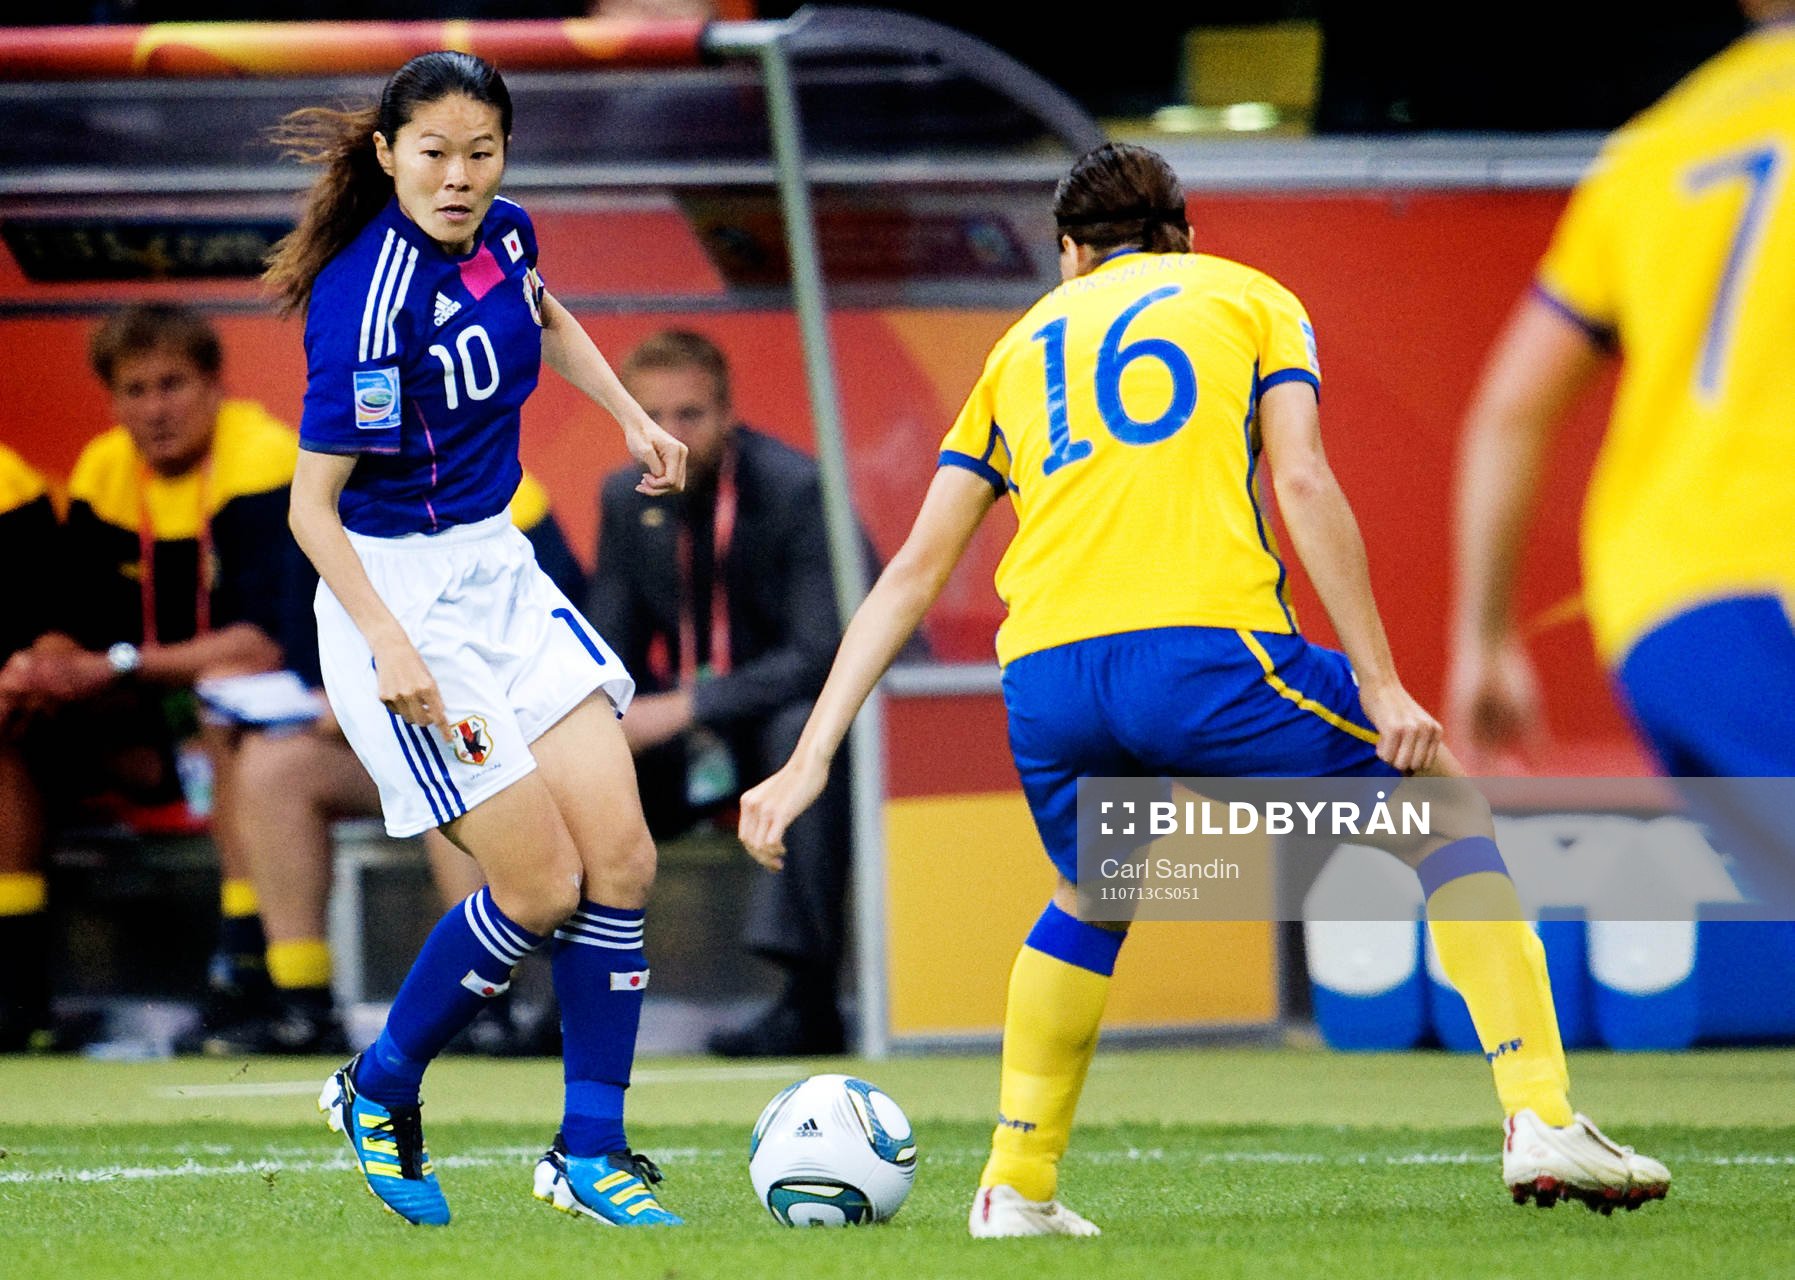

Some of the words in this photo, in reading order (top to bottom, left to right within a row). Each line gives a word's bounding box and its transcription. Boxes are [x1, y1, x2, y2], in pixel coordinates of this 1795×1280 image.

[1686, 144, 1779, 394] 7
[429, 325, 500, 410] 10
[1032, 286, 1198, 476] 16
